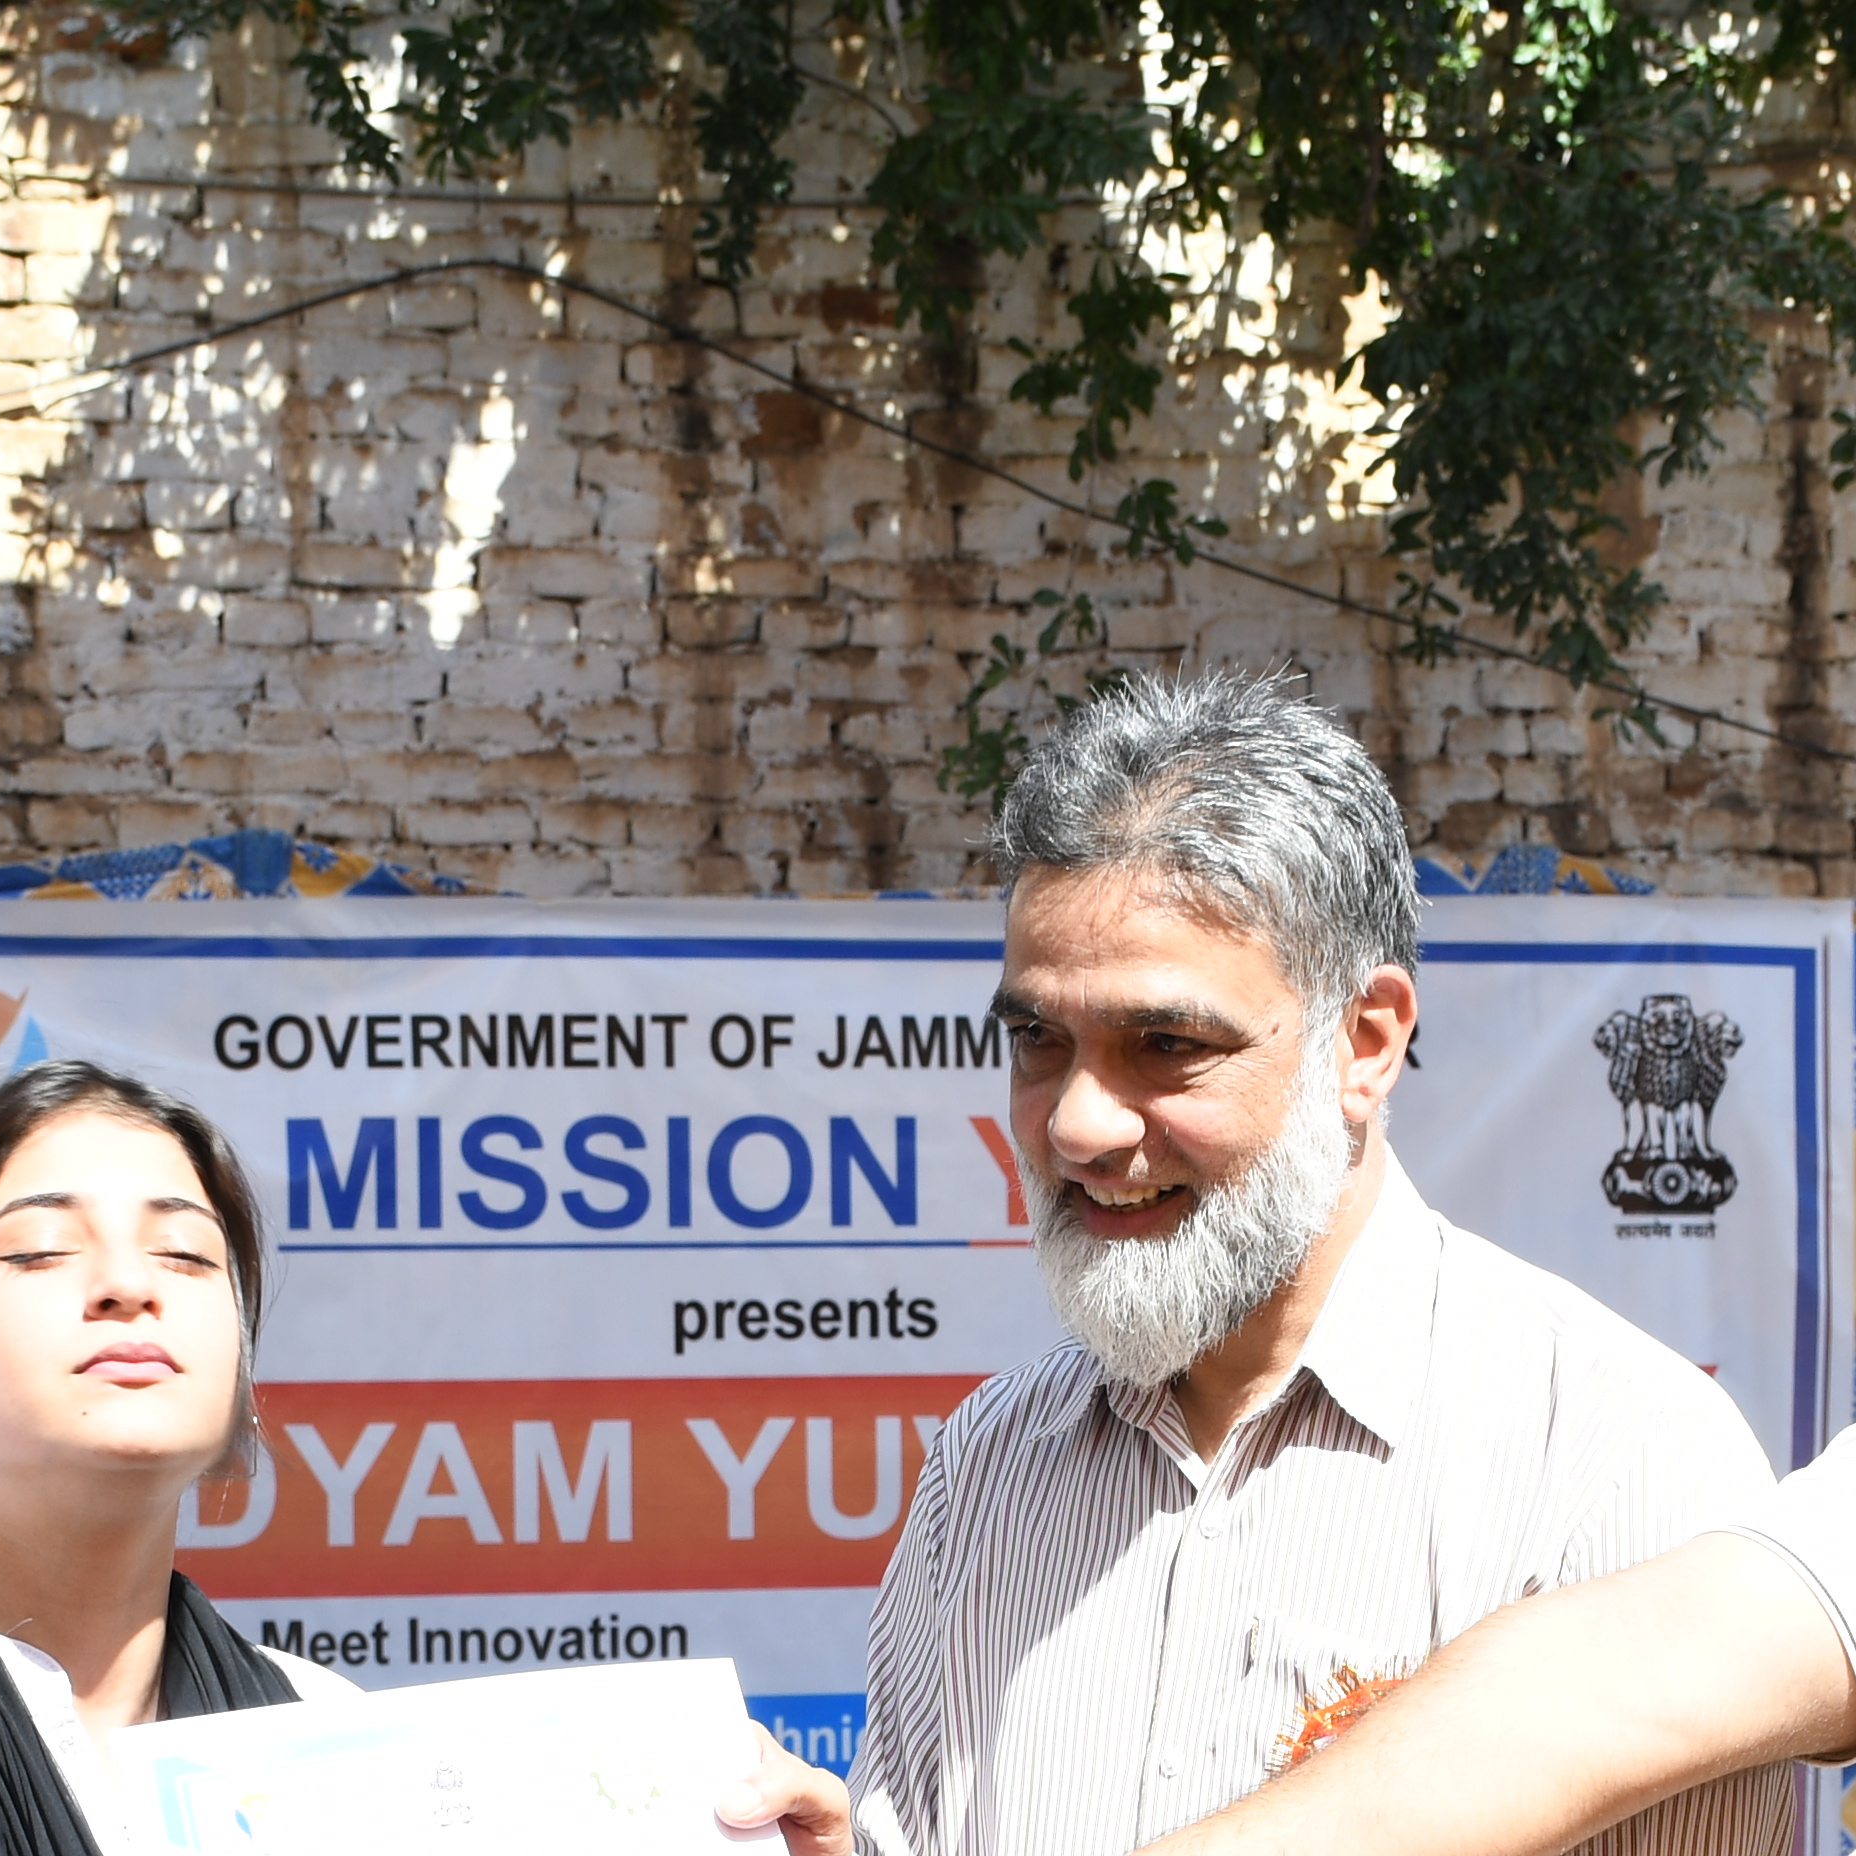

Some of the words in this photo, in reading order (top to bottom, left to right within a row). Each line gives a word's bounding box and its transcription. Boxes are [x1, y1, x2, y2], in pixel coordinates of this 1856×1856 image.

[214, 1014, 688, 1071] GOVERNMENT
[709, 1013, 794, 1070] OF
[817, 1014, 1013, 1070] JAMM
[284, 1114, 919, 1232] MISSION
[673, 1287, 938, 1356] presents
[261, 1619, 390, 1665] Meet
[408, 1614, 689, 1663] Innovation
